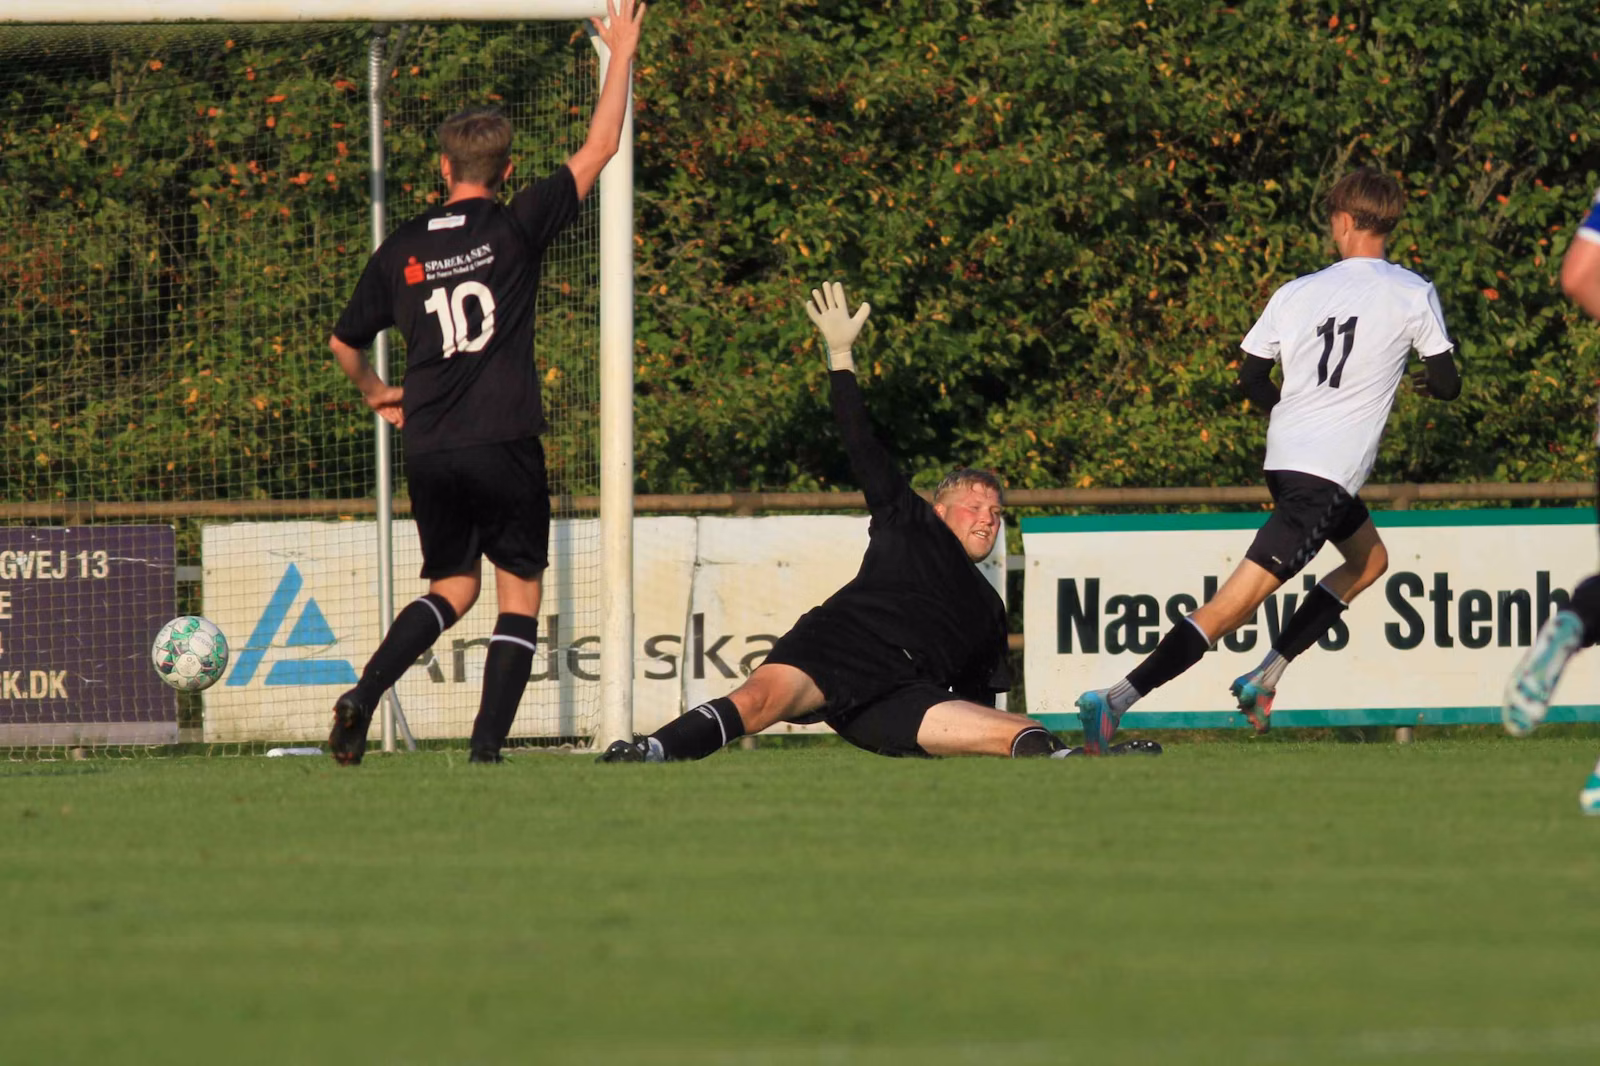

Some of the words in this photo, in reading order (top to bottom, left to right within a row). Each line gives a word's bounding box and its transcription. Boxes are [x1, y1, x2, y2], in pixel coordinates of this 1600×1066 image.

[424, 280, 496, 358] 10
[1316, 316, 1359, 389] 11
[0, 550, 67, 580] GVEJ
[77, 550, 109, 579] 13
[1384, 570, 1600, 651] Stenh
[0, 670, 69, 699] K.DK
